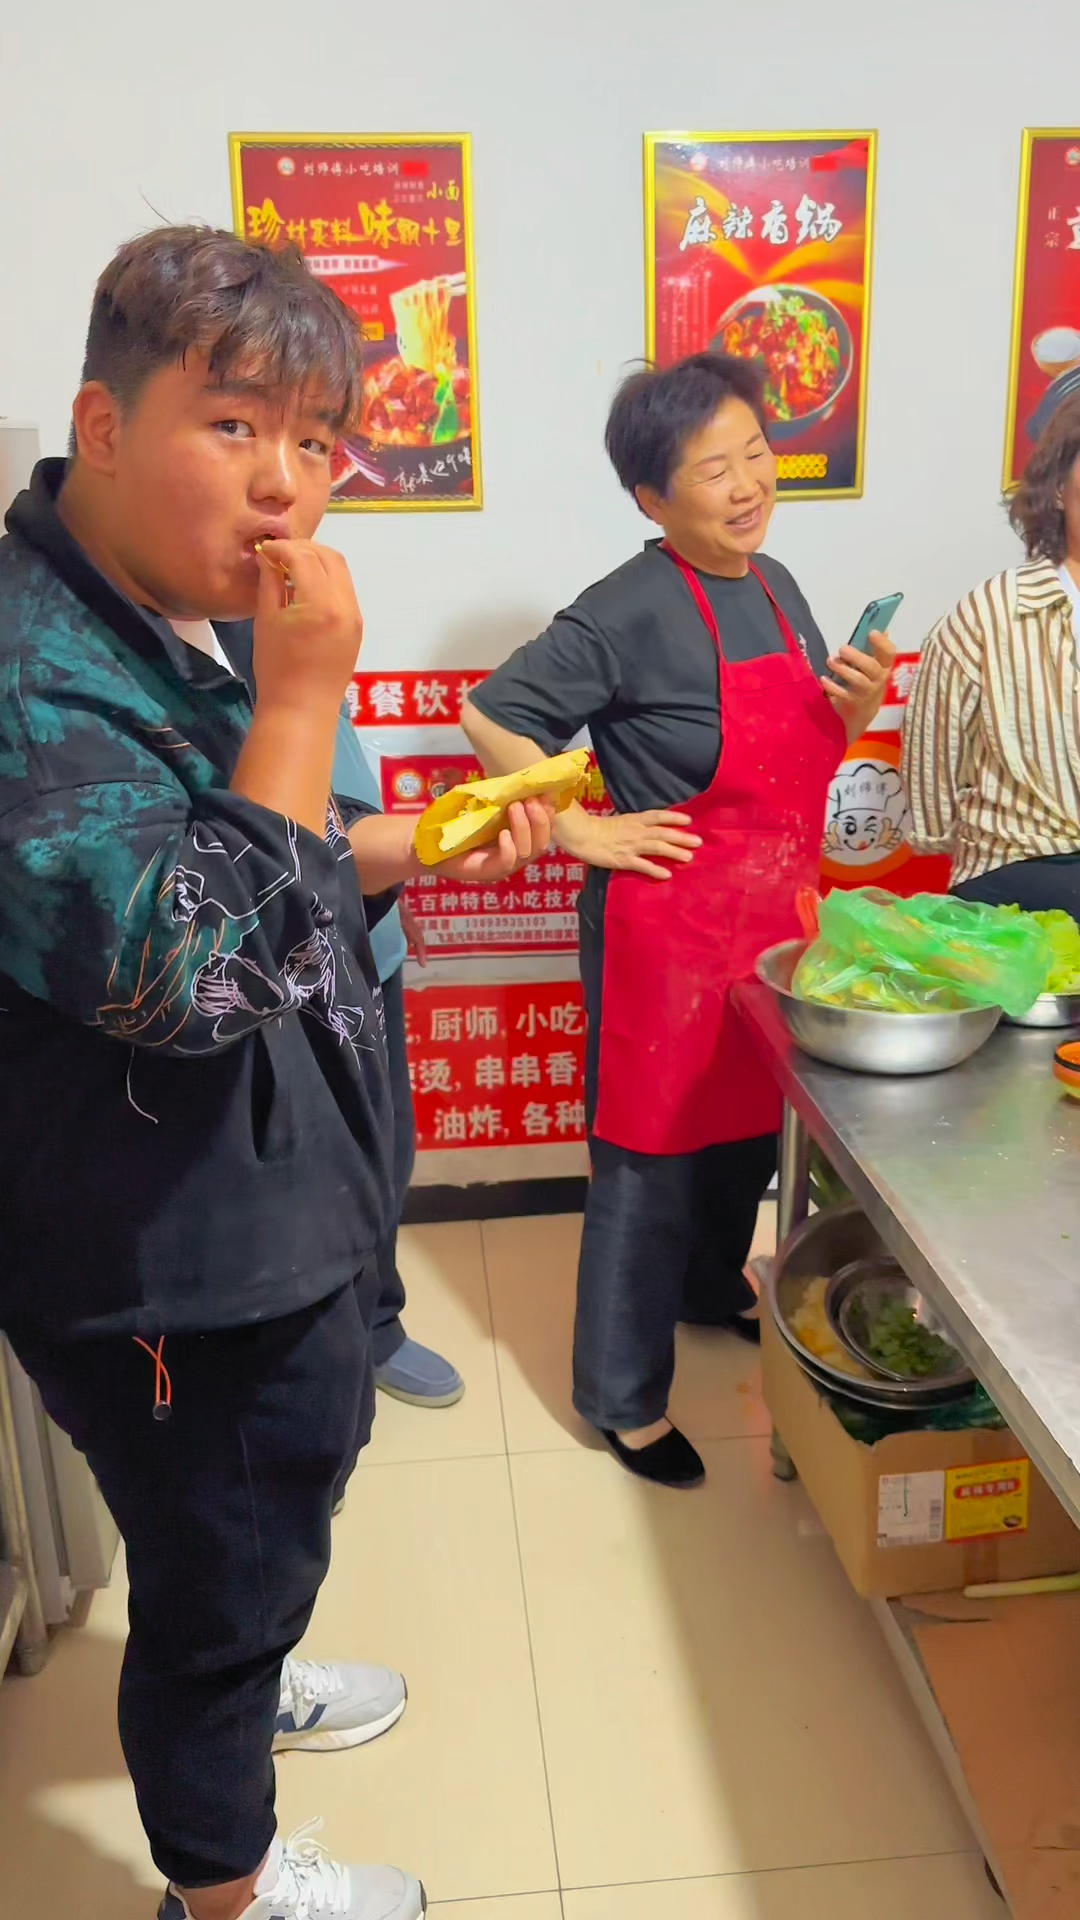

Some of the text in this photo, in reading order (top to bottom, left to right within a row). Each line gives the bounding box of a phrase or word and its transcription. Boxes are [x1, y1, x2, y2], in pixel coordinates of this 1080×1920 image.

[427, 180, 460, 202] 小面
[679, 193, 844, 251] 麻辣香锅
[404, 1002, 585, 1044] ，厨师，小吃
[408, 1051, 585, 1094] 烫，串串香，
